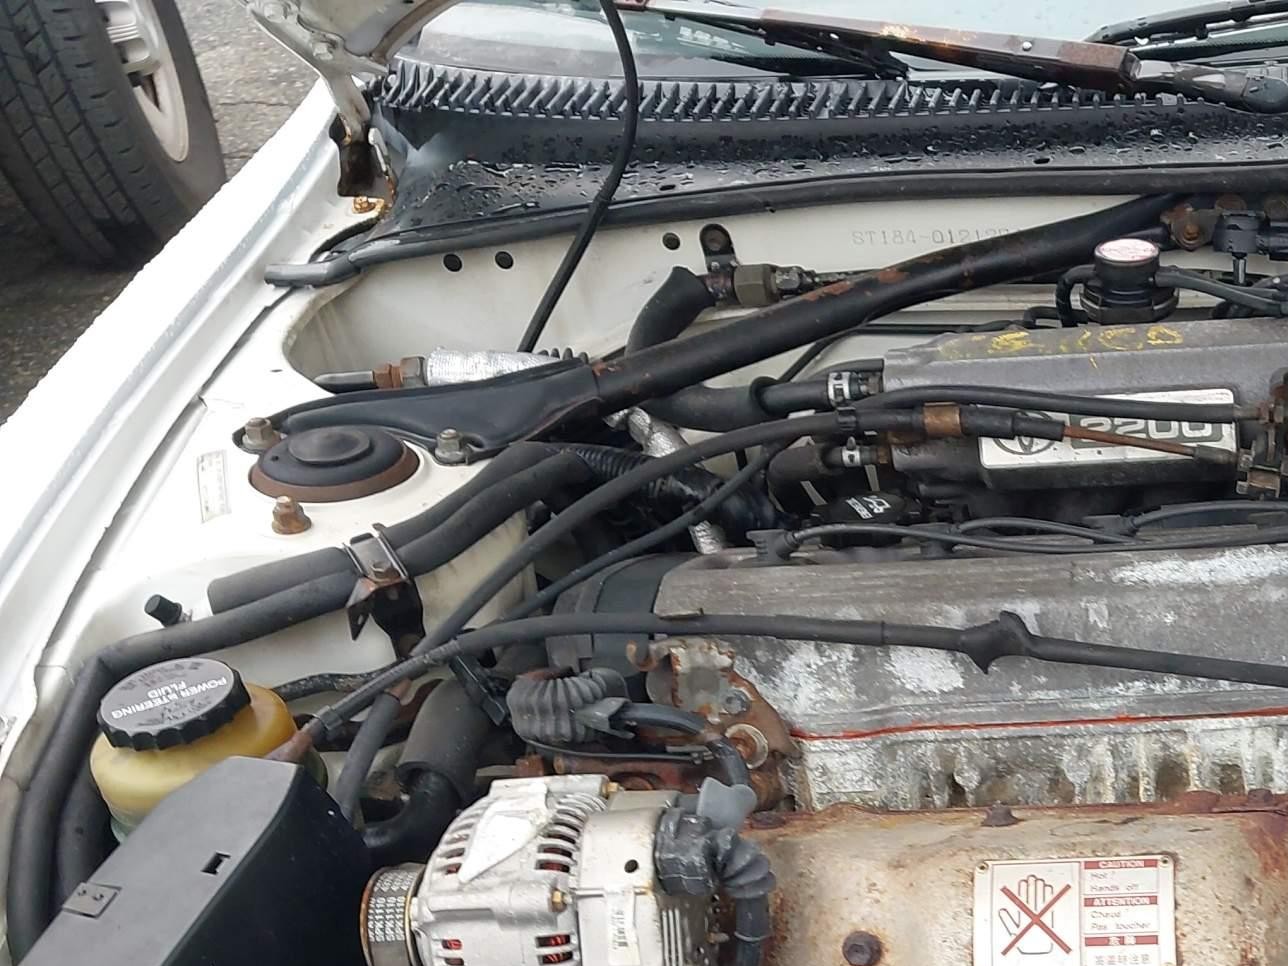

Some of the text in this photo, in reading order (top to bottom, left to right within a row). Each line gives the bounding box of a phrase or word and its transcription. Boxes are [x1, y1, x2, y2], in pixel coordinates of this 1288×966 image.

[147, 680, 188, 699] FLUID
[181, 676, 228, 699] POWER
[111, 693, 178, 719] STEERING
[1099, 860, 1145, 869] CAUTION
[1093, 897, 1151, 907] ATTENTION
